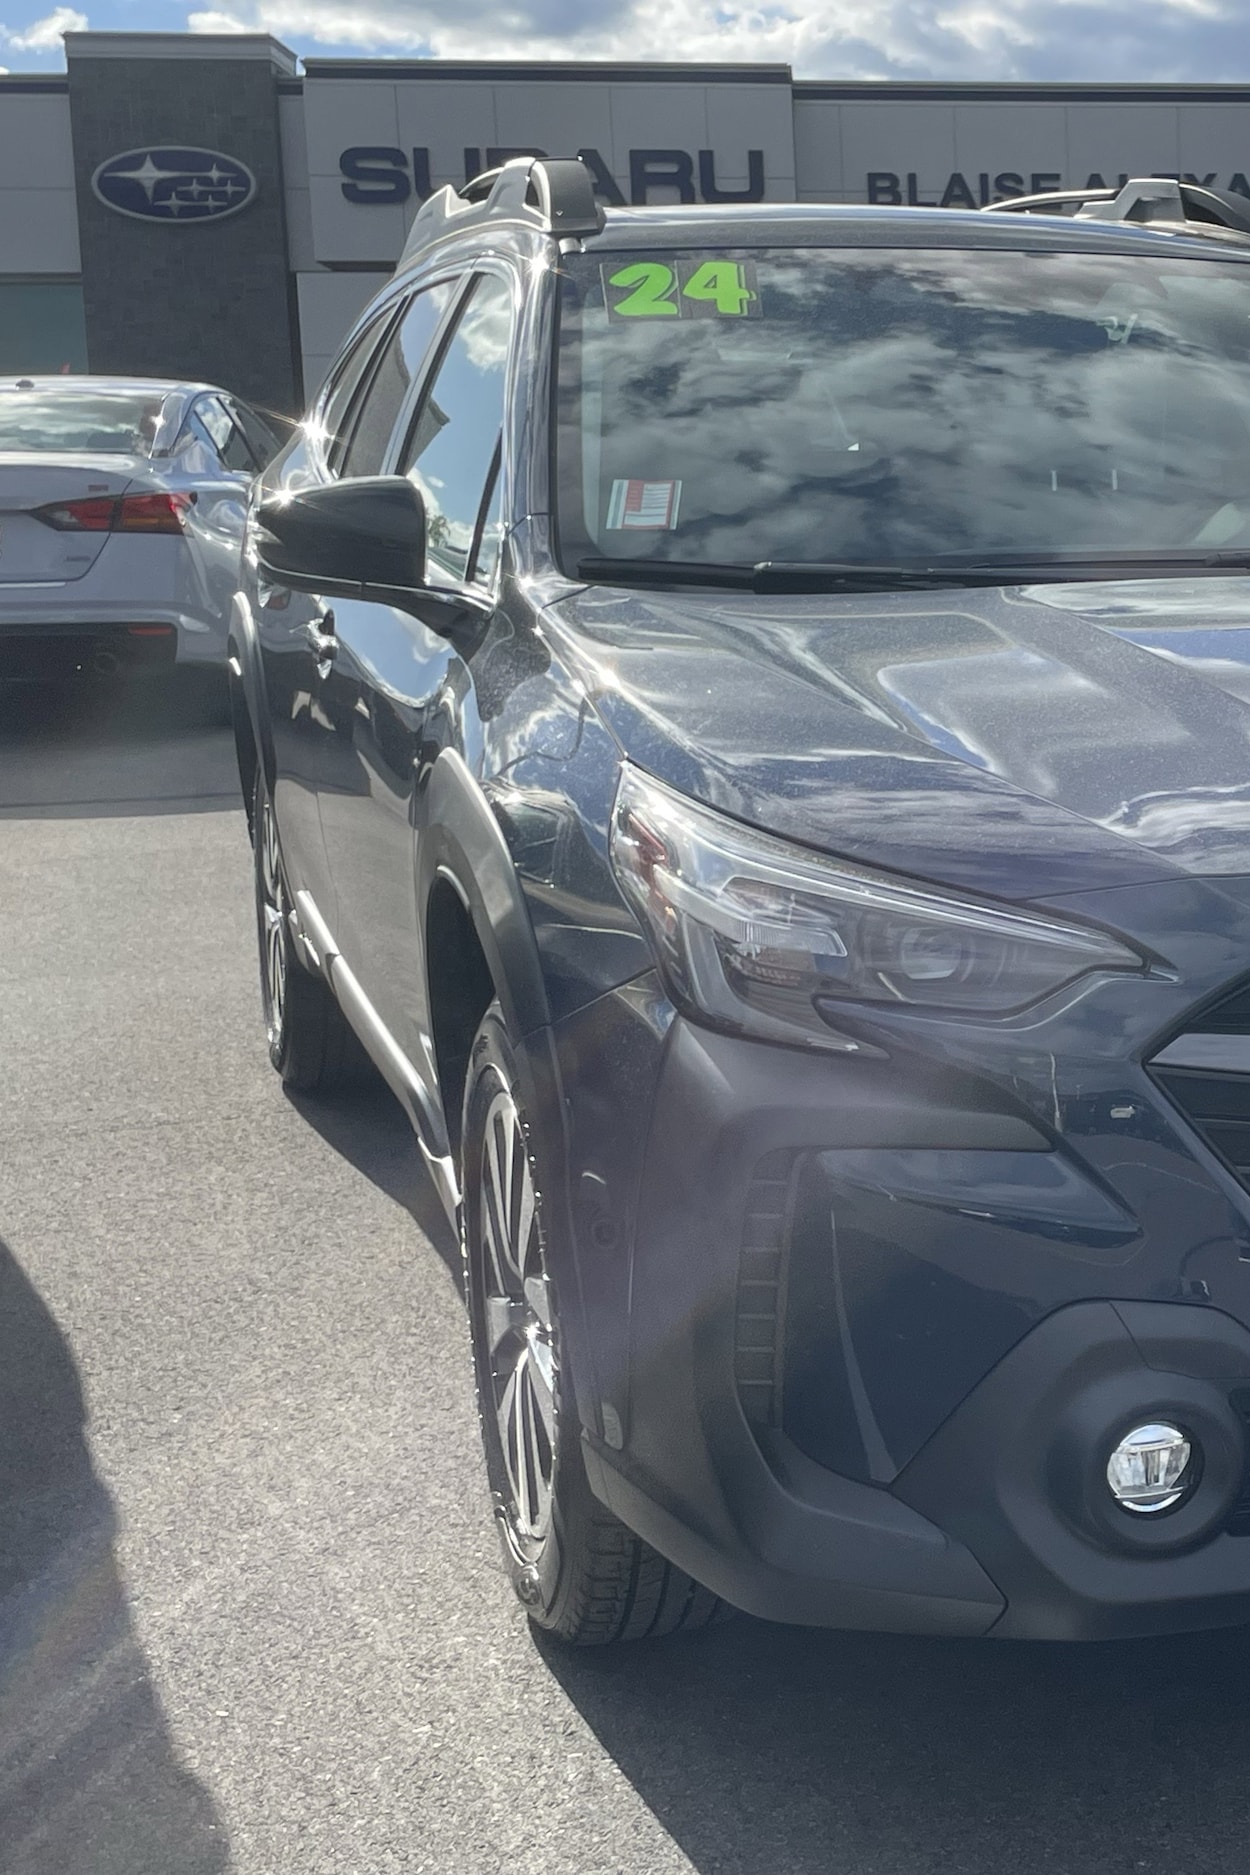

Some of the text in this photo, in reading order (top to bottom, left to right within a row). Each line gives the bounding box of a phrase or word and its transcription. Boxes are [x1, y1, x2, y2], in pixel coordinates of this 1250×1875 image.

[339, 146, 764, 205] SUARU
[866, 172, 1064, 210] BLAISE
[608, 261, 757, 316] 24
